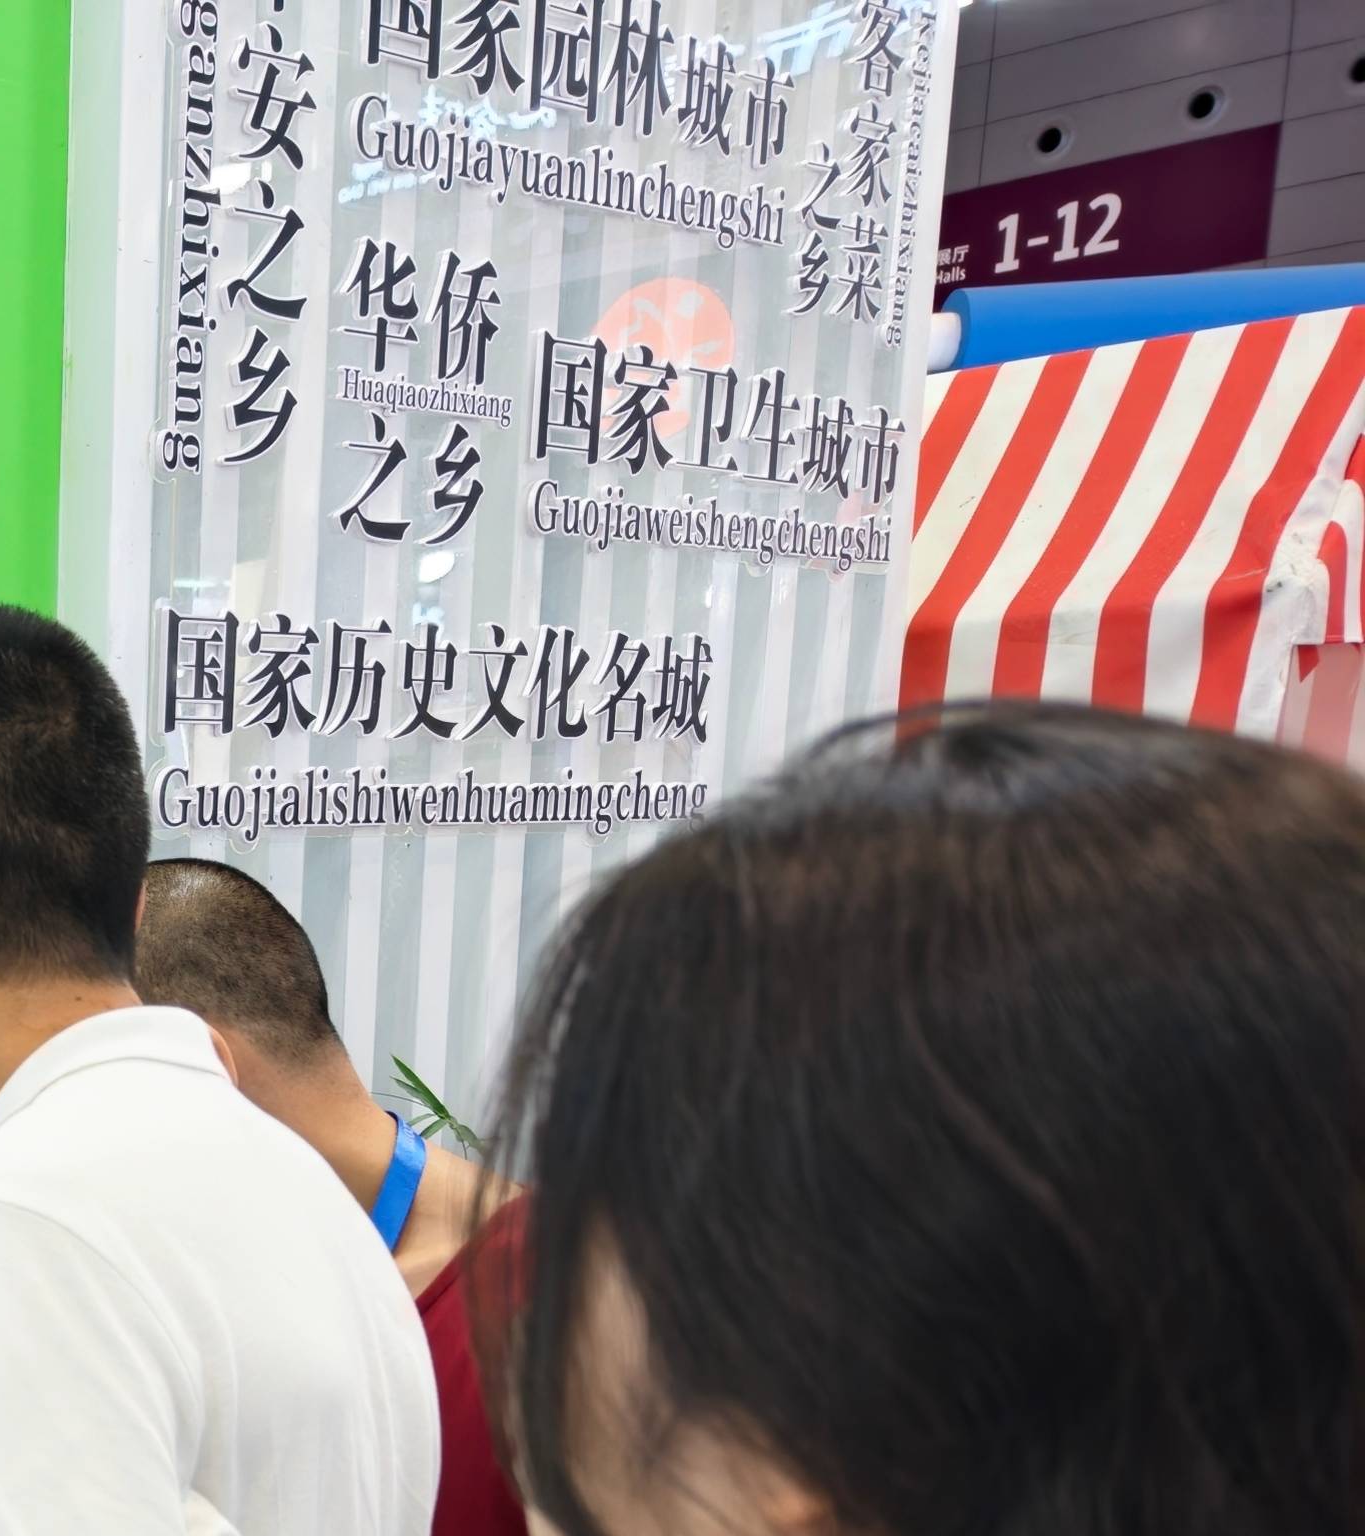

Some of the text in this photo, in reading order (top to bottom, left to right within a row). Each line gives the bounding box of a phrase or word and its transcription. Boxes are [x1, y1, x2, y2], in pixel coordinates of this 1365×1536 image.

[367, 0, 789, 165] 国家园林城市
[220, 0, 316, 462] 安之乡
[357, 95, 785, 249] Guojiayuanlinchengshi
[994, 193, 1122, 274] 1-12
[343, 239, 500, 386] 华侨
[343, 368, 512, 427] Huaqiaozhixiang
[536, 332, 906, 505] 国家卫生城市
[339, 415, 485, 546] 之乡
[533, 481, 892, 572] Guojiaweishengchengshi
[164, 609, 713, 744] 国家历史文化名城
[159, 768, 709, 842] Guojialishiwenhuamingcheng
